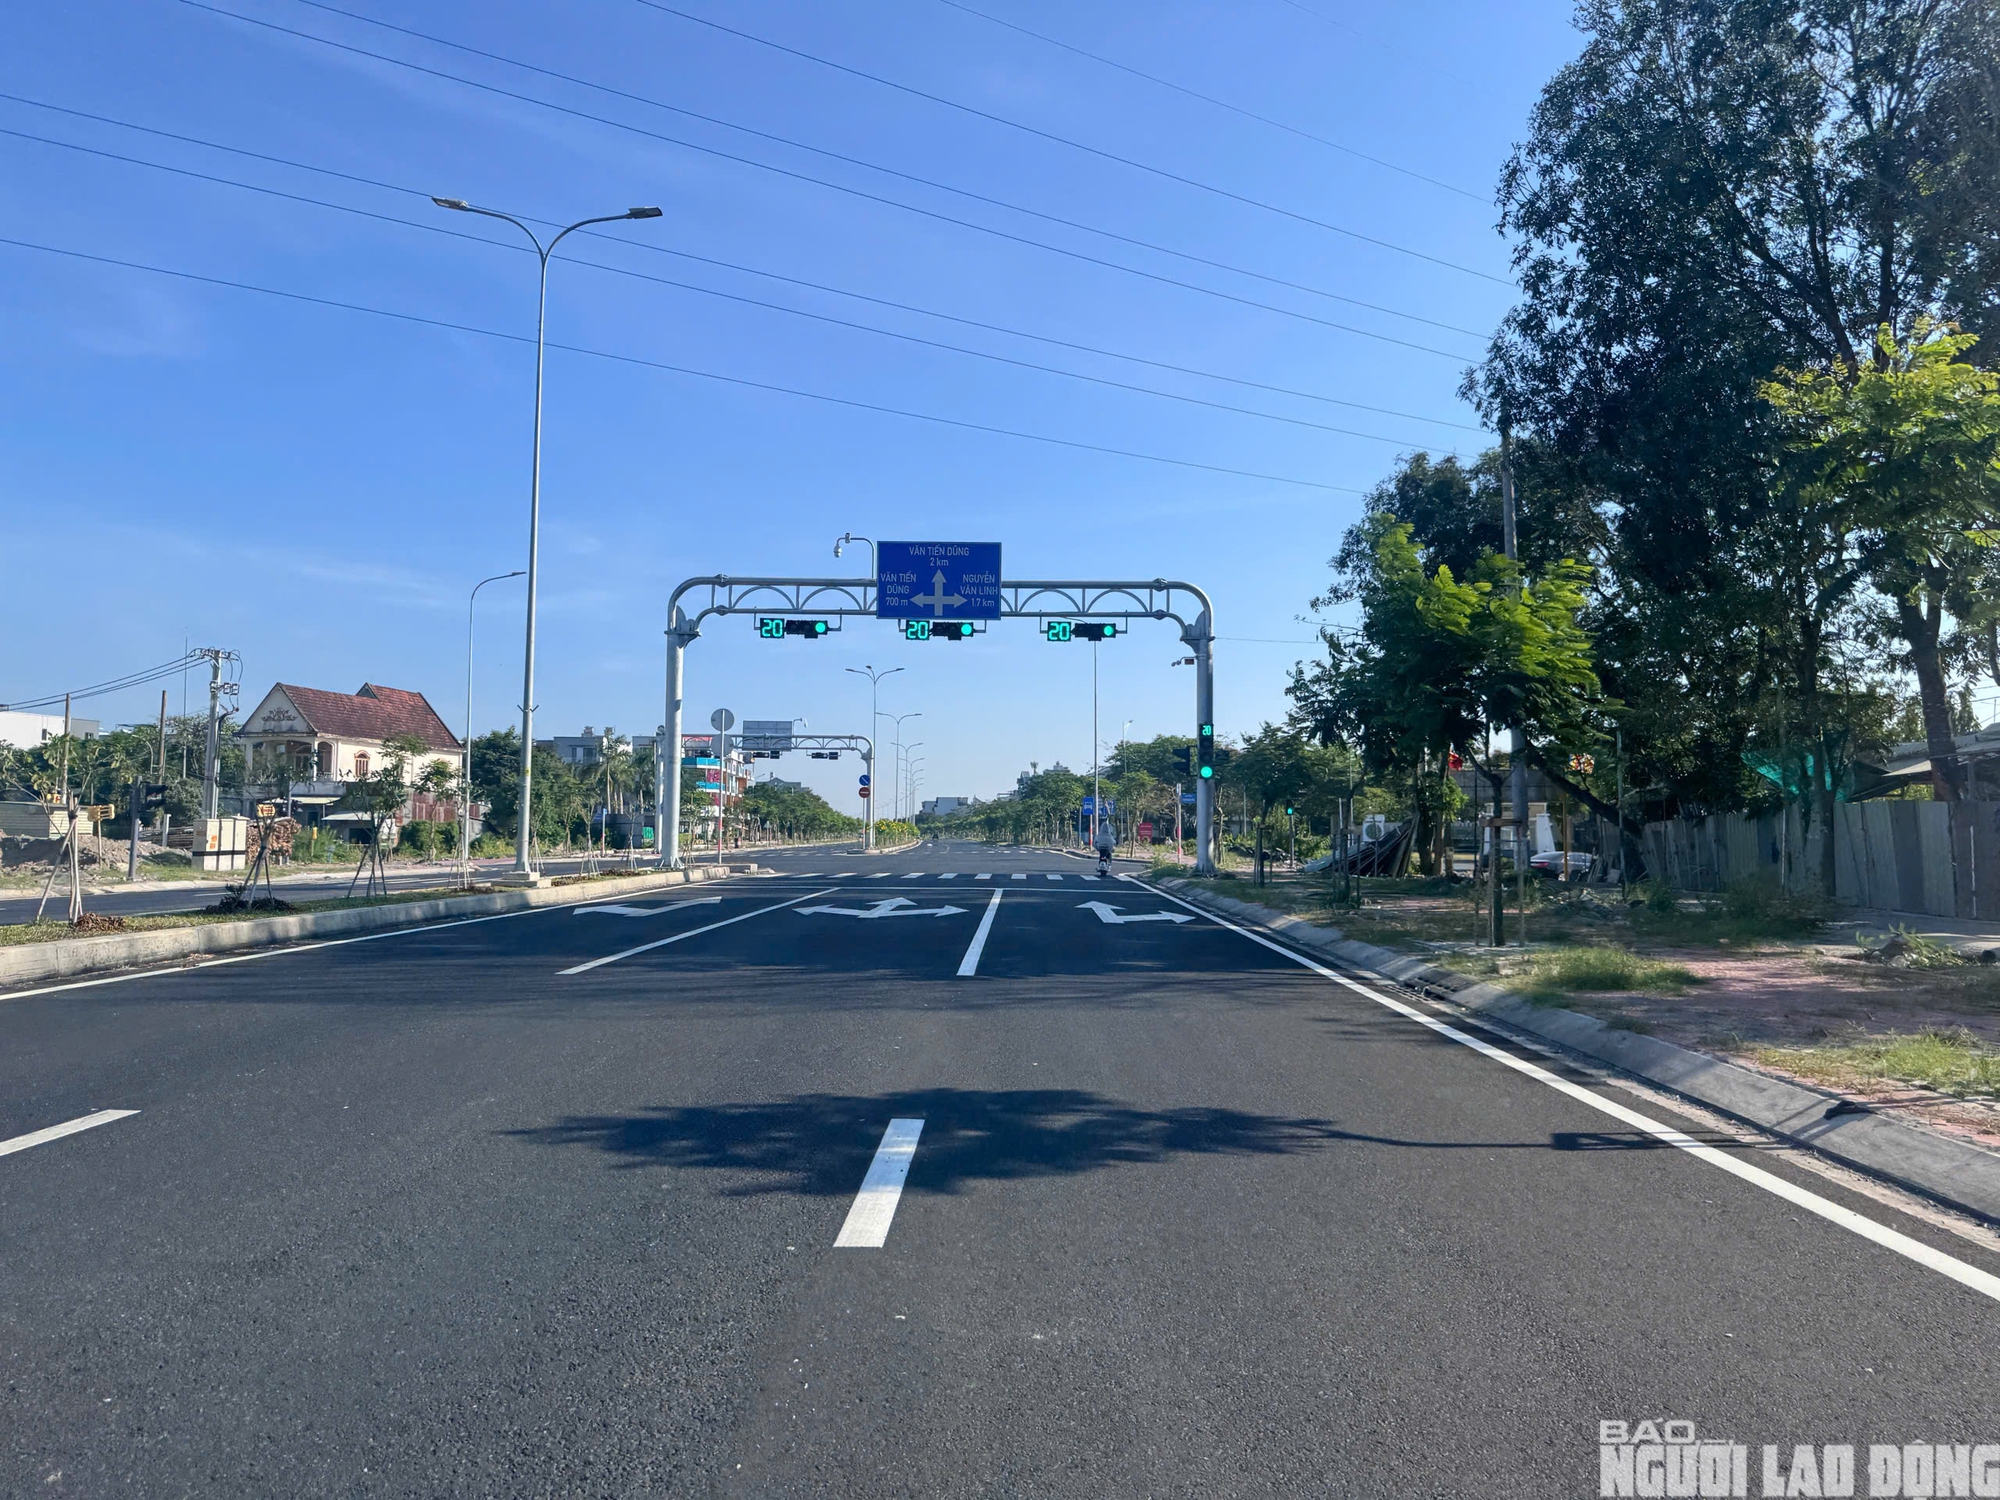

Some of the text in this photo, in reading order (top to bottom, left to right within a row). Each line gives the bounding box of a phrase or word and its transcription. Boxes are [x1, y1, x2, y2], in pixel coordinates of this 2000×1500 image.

[909, 544, 970, 556] VĂN TIẾN DŨNG
[930, 557, 949, 566] 2 km
[880, 570, 917, 583] VĂN TIẾN
[886, 583, 910, 594] DŨNG
[960, 584, 998, 596] VĂN LINH
[885, 597, 899, 606] 700
[982, 598, 995, 607] km
[762, 619, 783, 637] 20
[907, 621, 929, 639] 20
[1048, 622, 1070, 640] 20
[1202, 725, 1212, 736] 20
